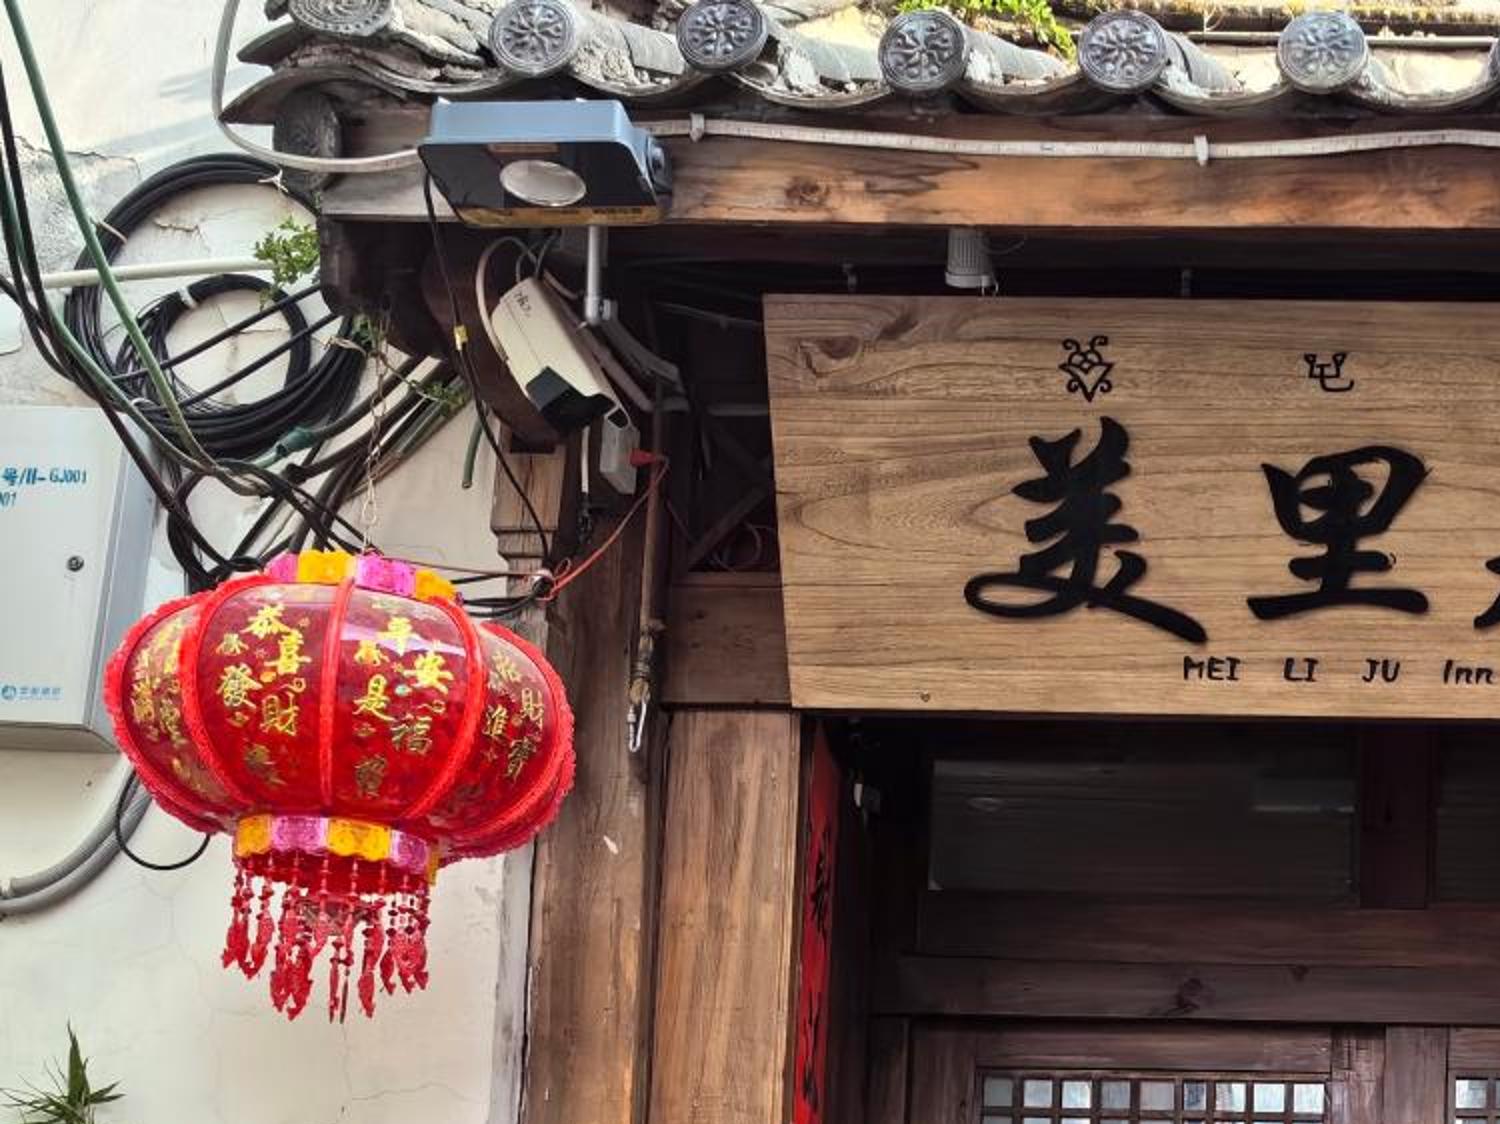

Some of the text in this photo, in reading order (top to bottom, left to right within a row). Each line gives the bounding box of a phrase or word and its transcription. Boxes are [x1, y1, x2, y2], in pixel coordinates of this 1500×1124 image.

[1183, 655, 1495, 685] MEI LI JU Inn
